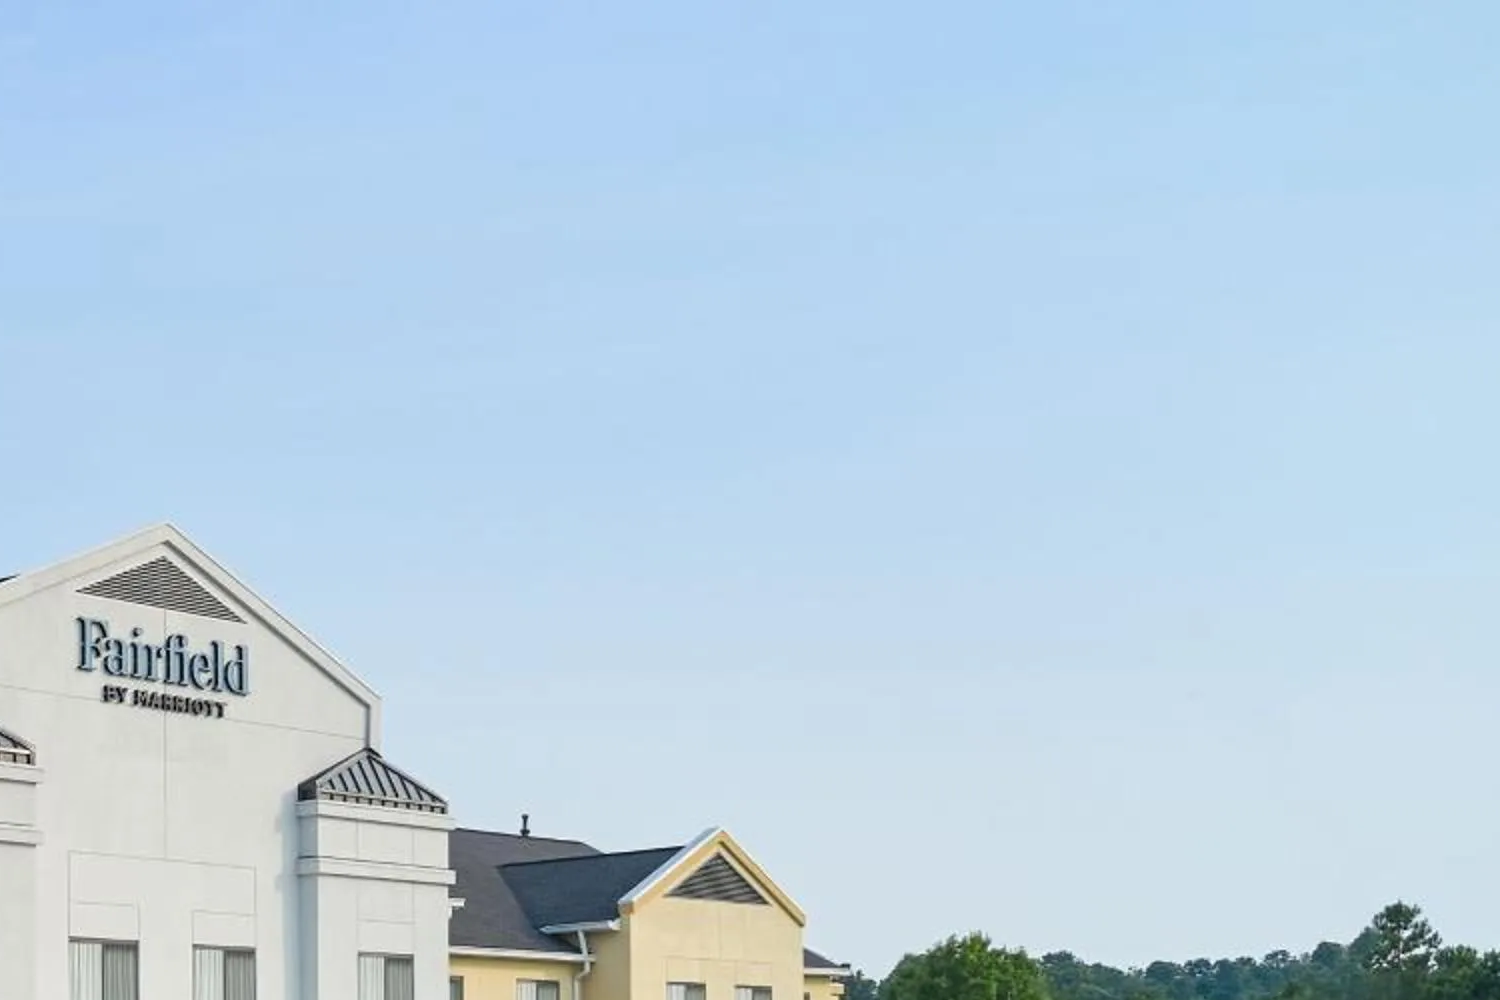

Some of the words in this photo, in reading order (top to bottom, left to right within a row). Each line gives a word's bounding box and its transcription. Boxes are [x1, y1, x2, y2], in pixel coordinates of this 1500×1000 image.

[76, 617, 249, 696] Fairfield
[102, 685, 128, 703] BY
[132, 690, 226, 718] MARRIOTT
